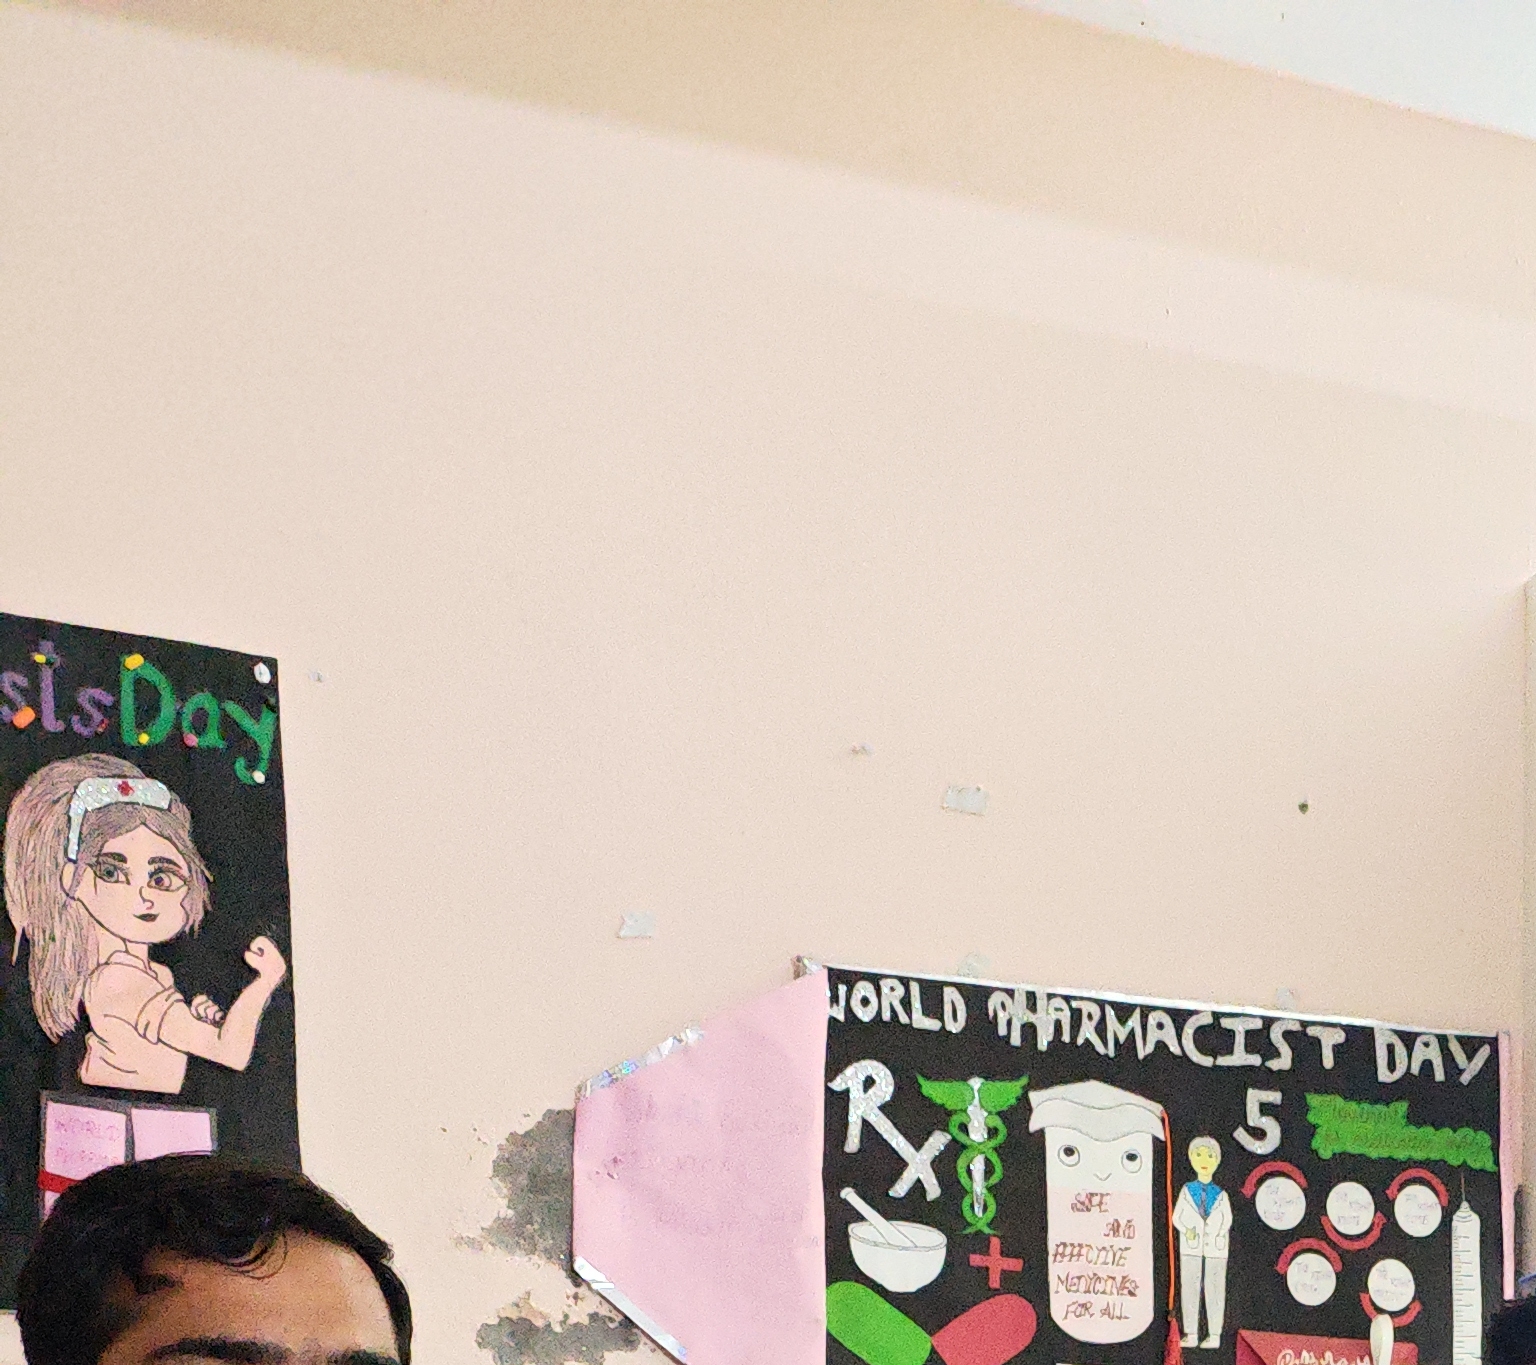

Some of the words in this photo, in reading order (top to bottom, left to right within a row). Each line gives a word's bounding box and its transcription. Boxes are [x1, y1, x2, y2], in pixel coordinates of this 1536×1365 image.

[120, 655, 277, 786] Day
[988, 987, 1347, 1071] PHARMACIST
[1373, 1027, 1491, 1086] DAY
[1233, 1088, 1283, 1155] 5
